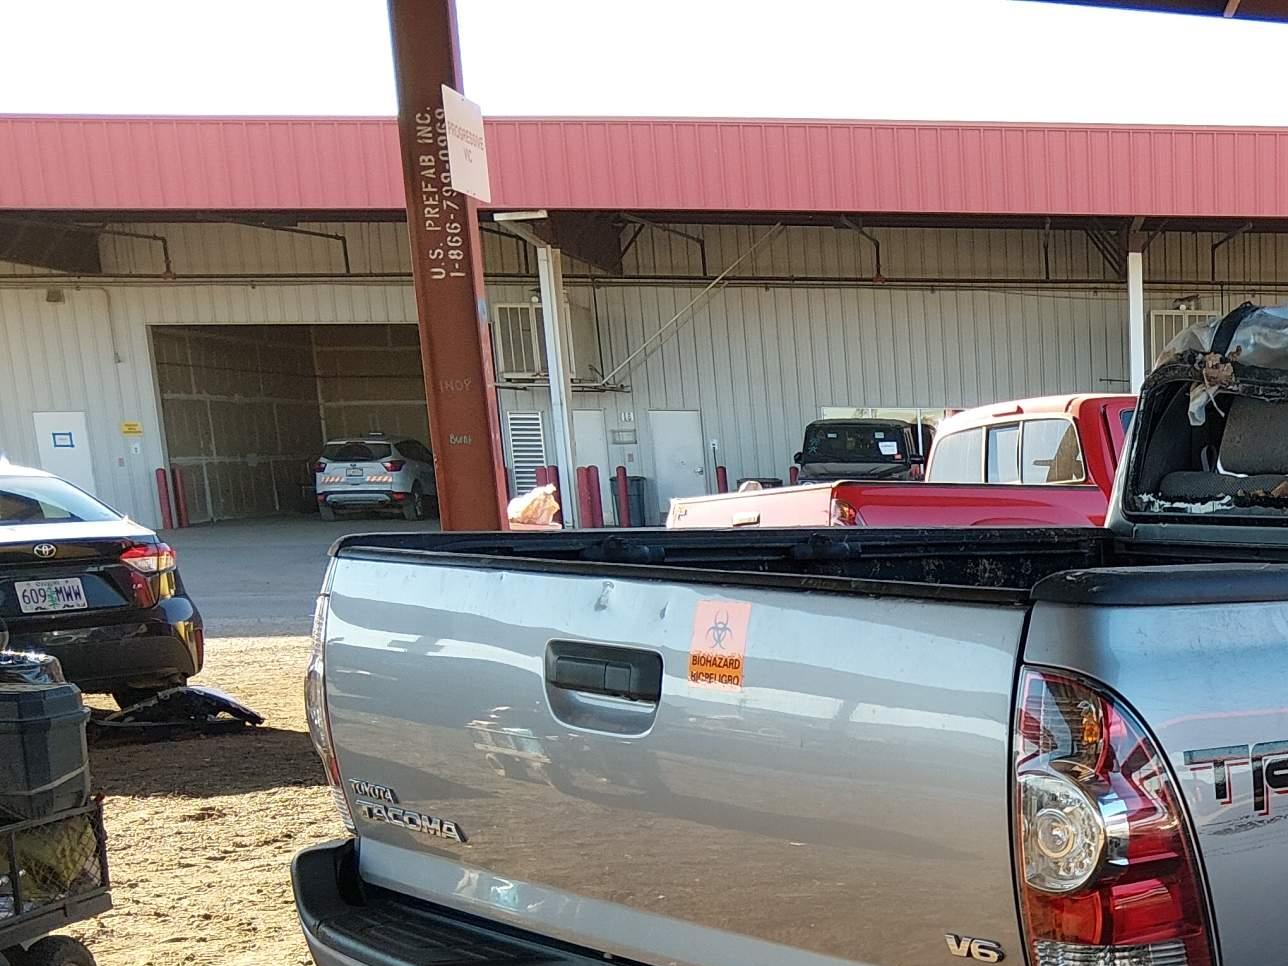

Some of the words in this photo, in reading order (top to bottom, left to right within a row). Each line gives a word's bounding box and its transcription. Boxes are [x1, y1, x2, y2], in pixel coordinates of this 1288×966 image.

[415, 106, 434, 144] INC.
[419, 155, 442, 231] PREFAB
[428, 243, 446, 279] U.S.
[22, 588, 47, 605] 609
[55, 584, 82, 602] MWW
[692, 655, 741, 670] BIOHAZARD
[348, 778, 398, 804] TOYOTA
[356, 800, 467, 842] TACOMA
[944, 933, 1005, 963] V6
